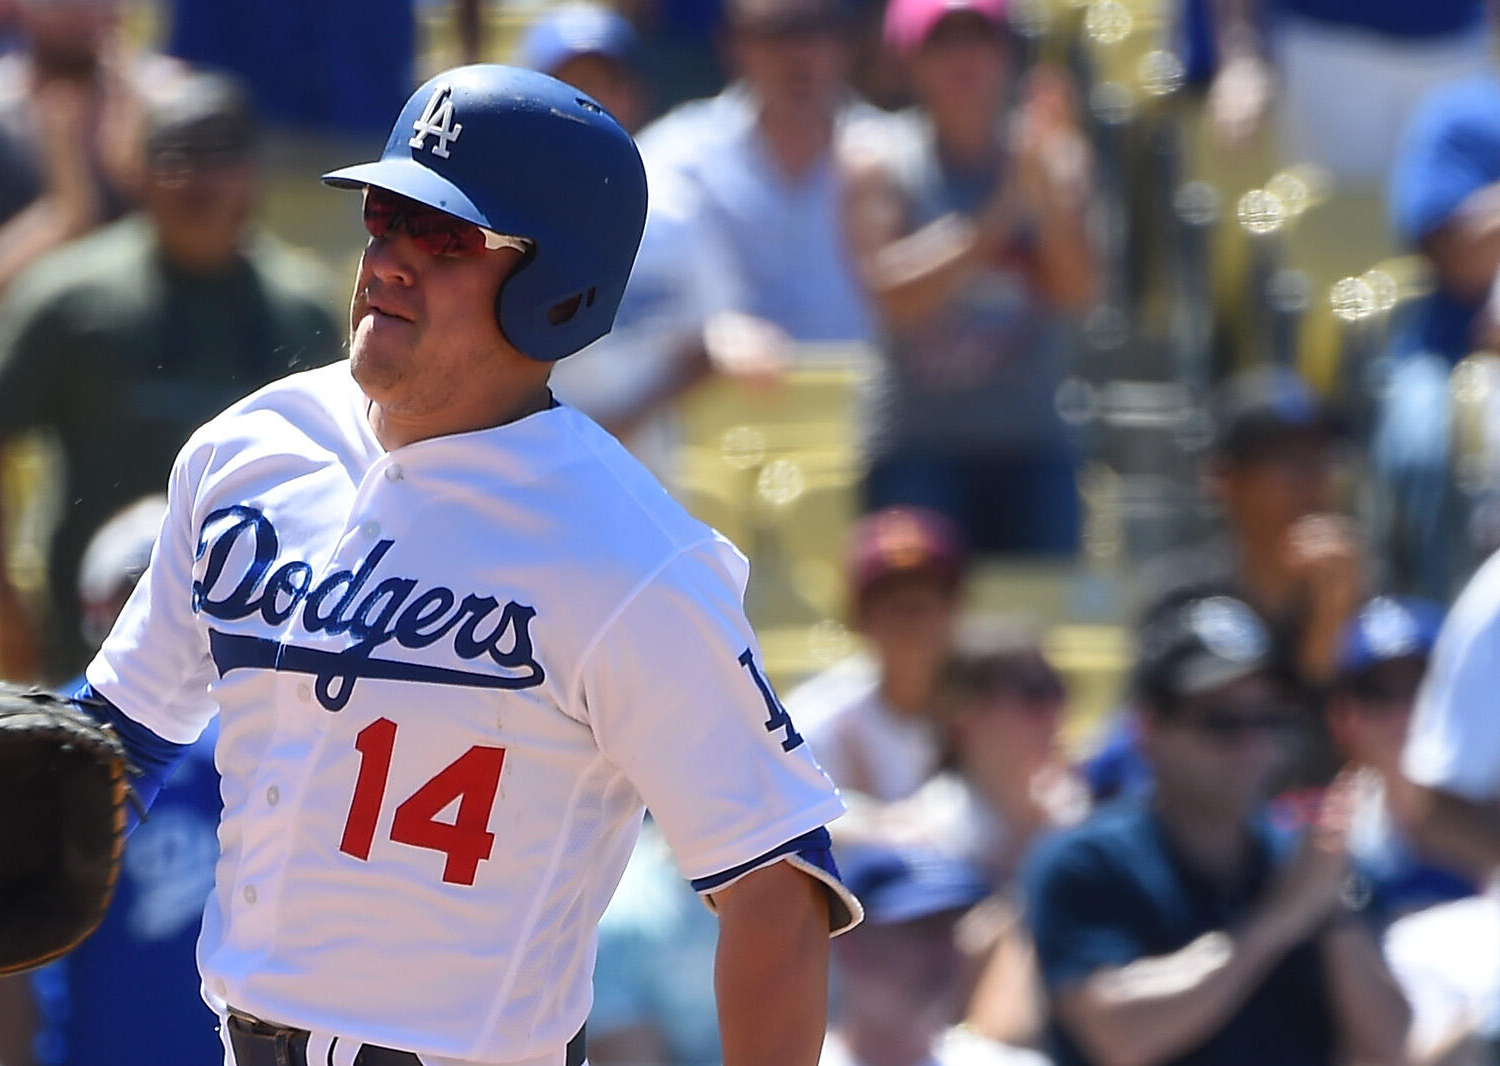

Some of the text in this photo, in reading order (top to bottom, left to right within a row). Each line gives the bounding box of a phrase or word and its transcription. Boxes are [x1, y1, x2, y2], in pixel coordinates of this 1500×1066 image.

[409, 82, 462, 159] LA
[191, 504, 545, 712] Dodgers
[340, 717, 506, 887] 14
